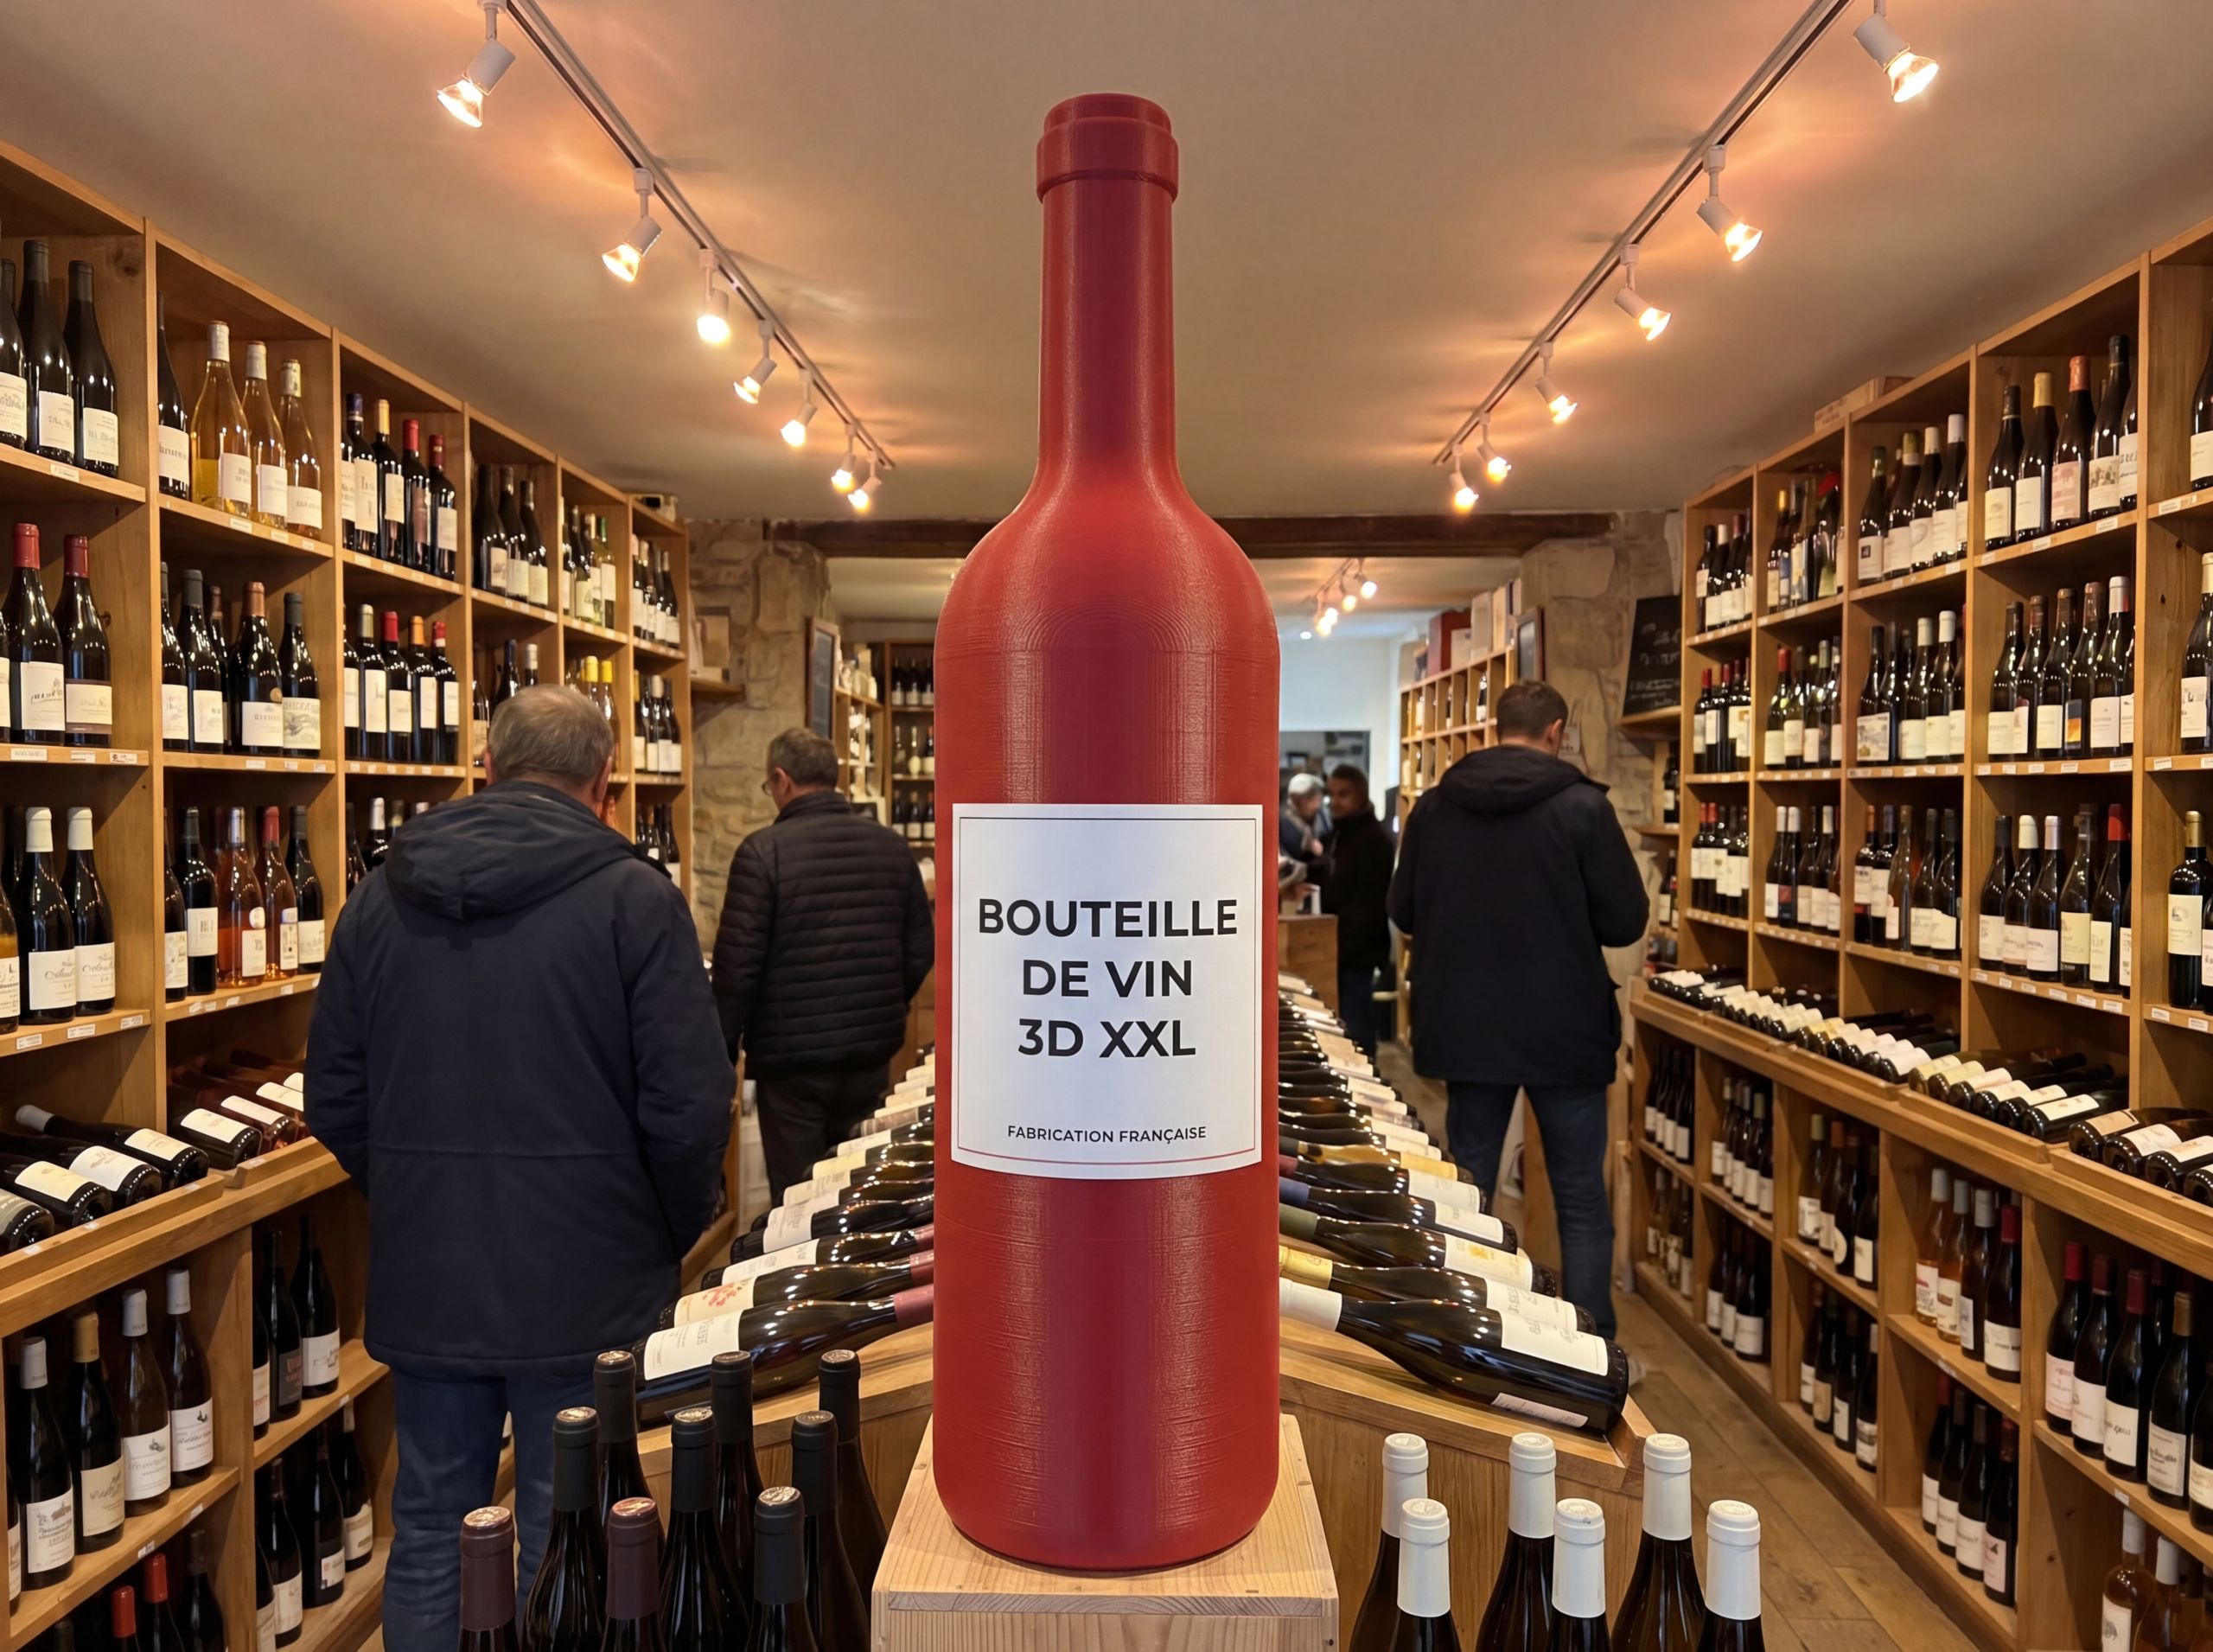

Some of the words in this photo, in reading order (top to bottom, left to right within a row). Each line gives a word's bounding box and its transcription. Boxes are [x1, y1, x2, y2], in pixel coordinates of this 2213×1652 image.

[979, 898, 1237, 938] BOUTEILLE
[1023, 960, 1089, 998] DE
[1105, 960, 1192, 998] VIN
[1017, 1018, 1084, 1056] 3D
[1099, 1020, 1196, 1057] XXL
[1007, 1126, 1113, 1143] FABRICATION
[1119, 1126, 1207, 1145] FRANÇAISE
